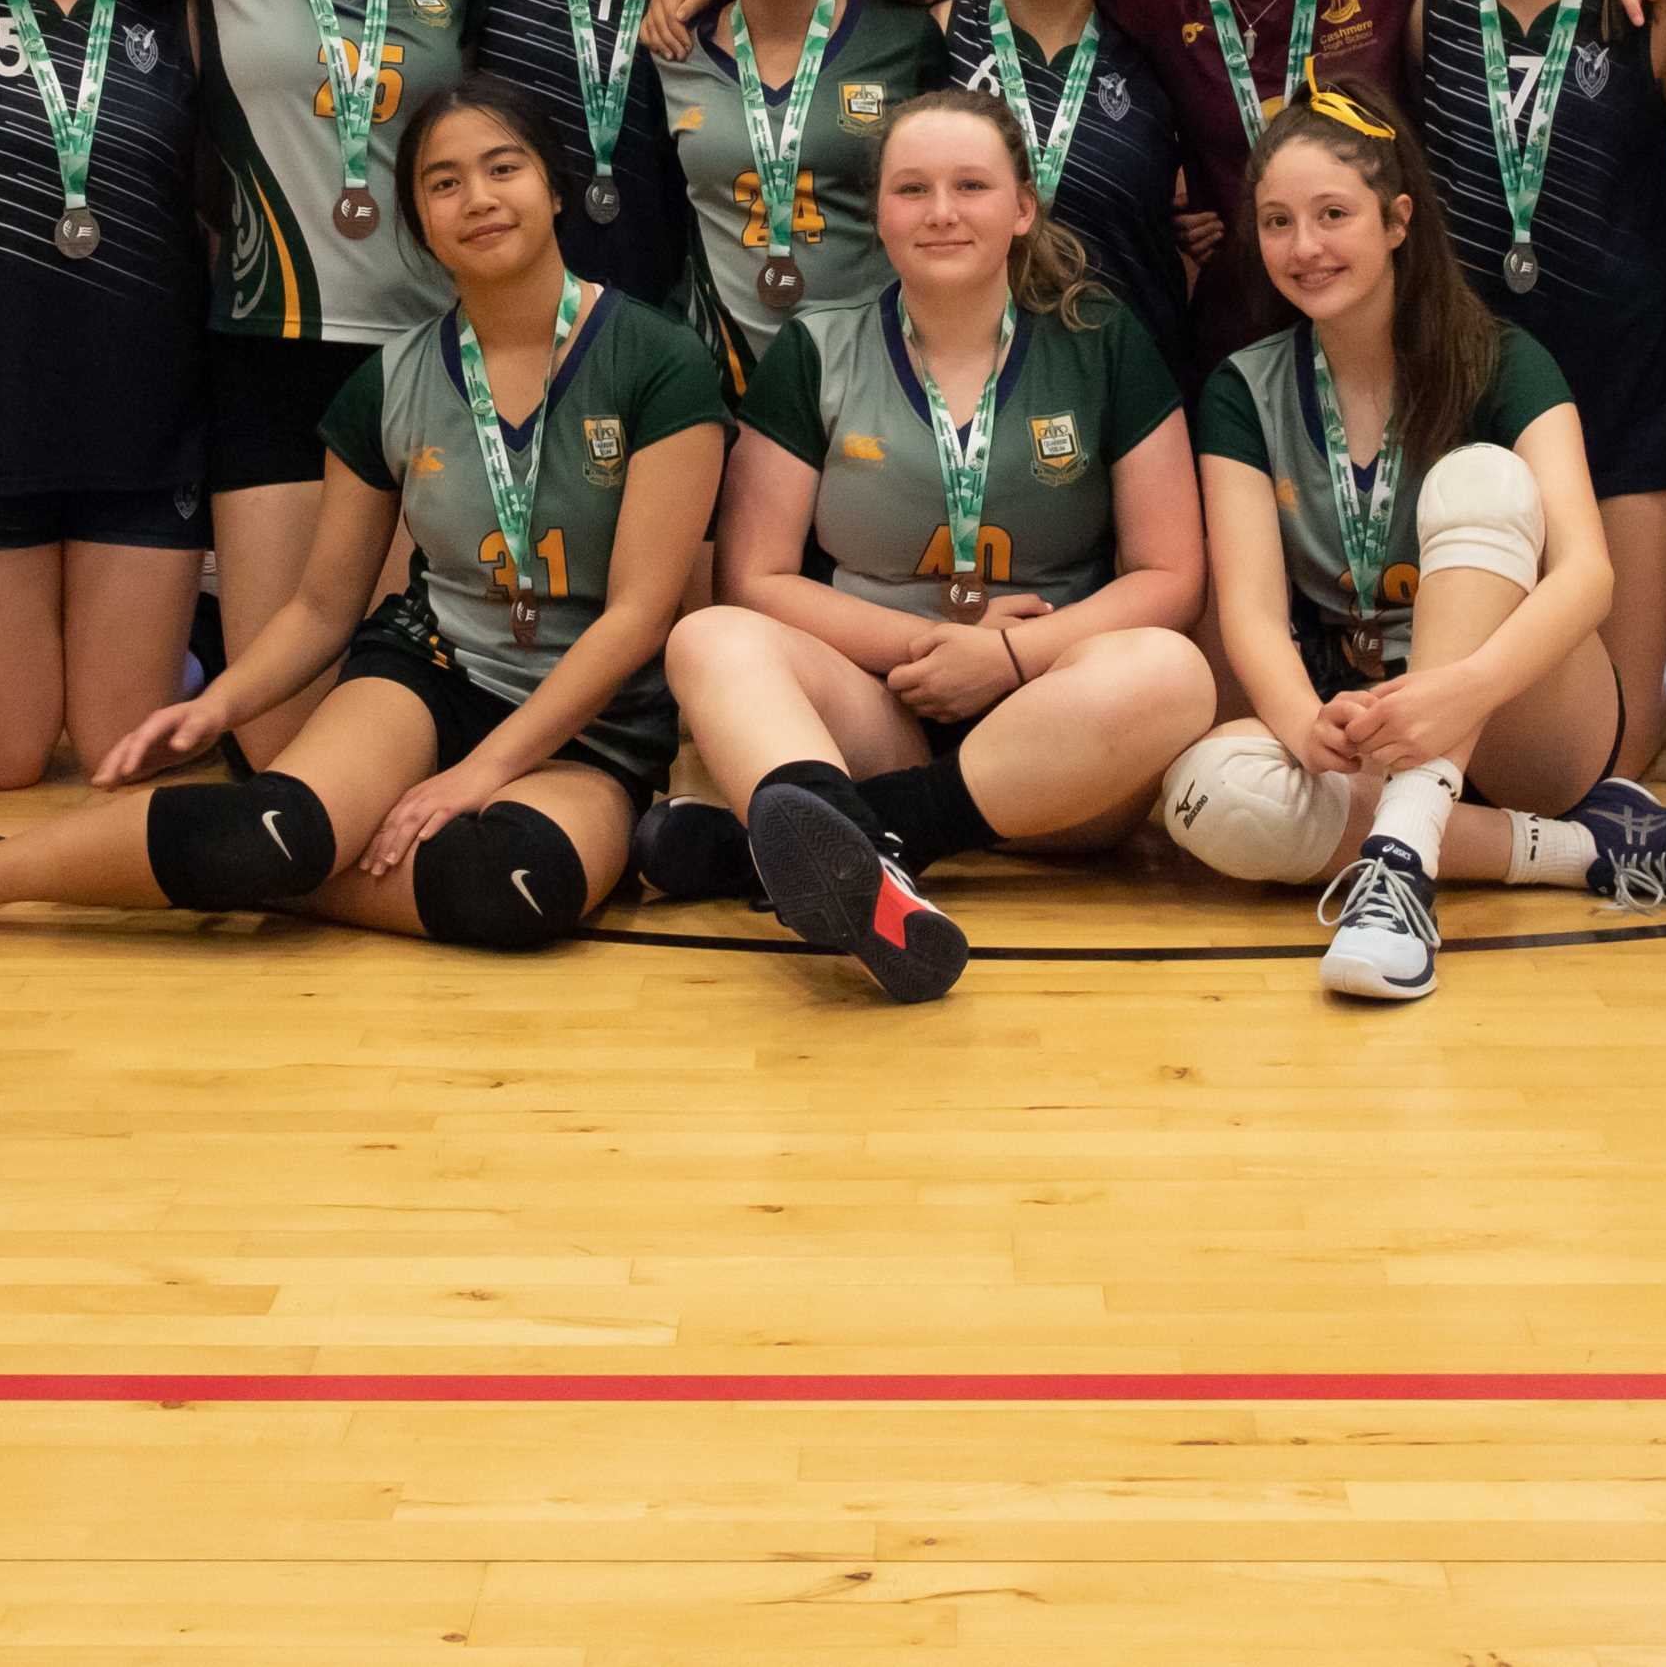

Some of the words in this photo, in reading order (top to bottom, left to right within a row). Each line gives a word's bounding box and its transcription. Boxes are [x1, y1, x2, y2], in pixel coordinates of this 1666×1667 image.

[1509, 54, 1546, 122] 7
[733, 167, 827, 248] 24
[478, 527, 570, 599] 31
